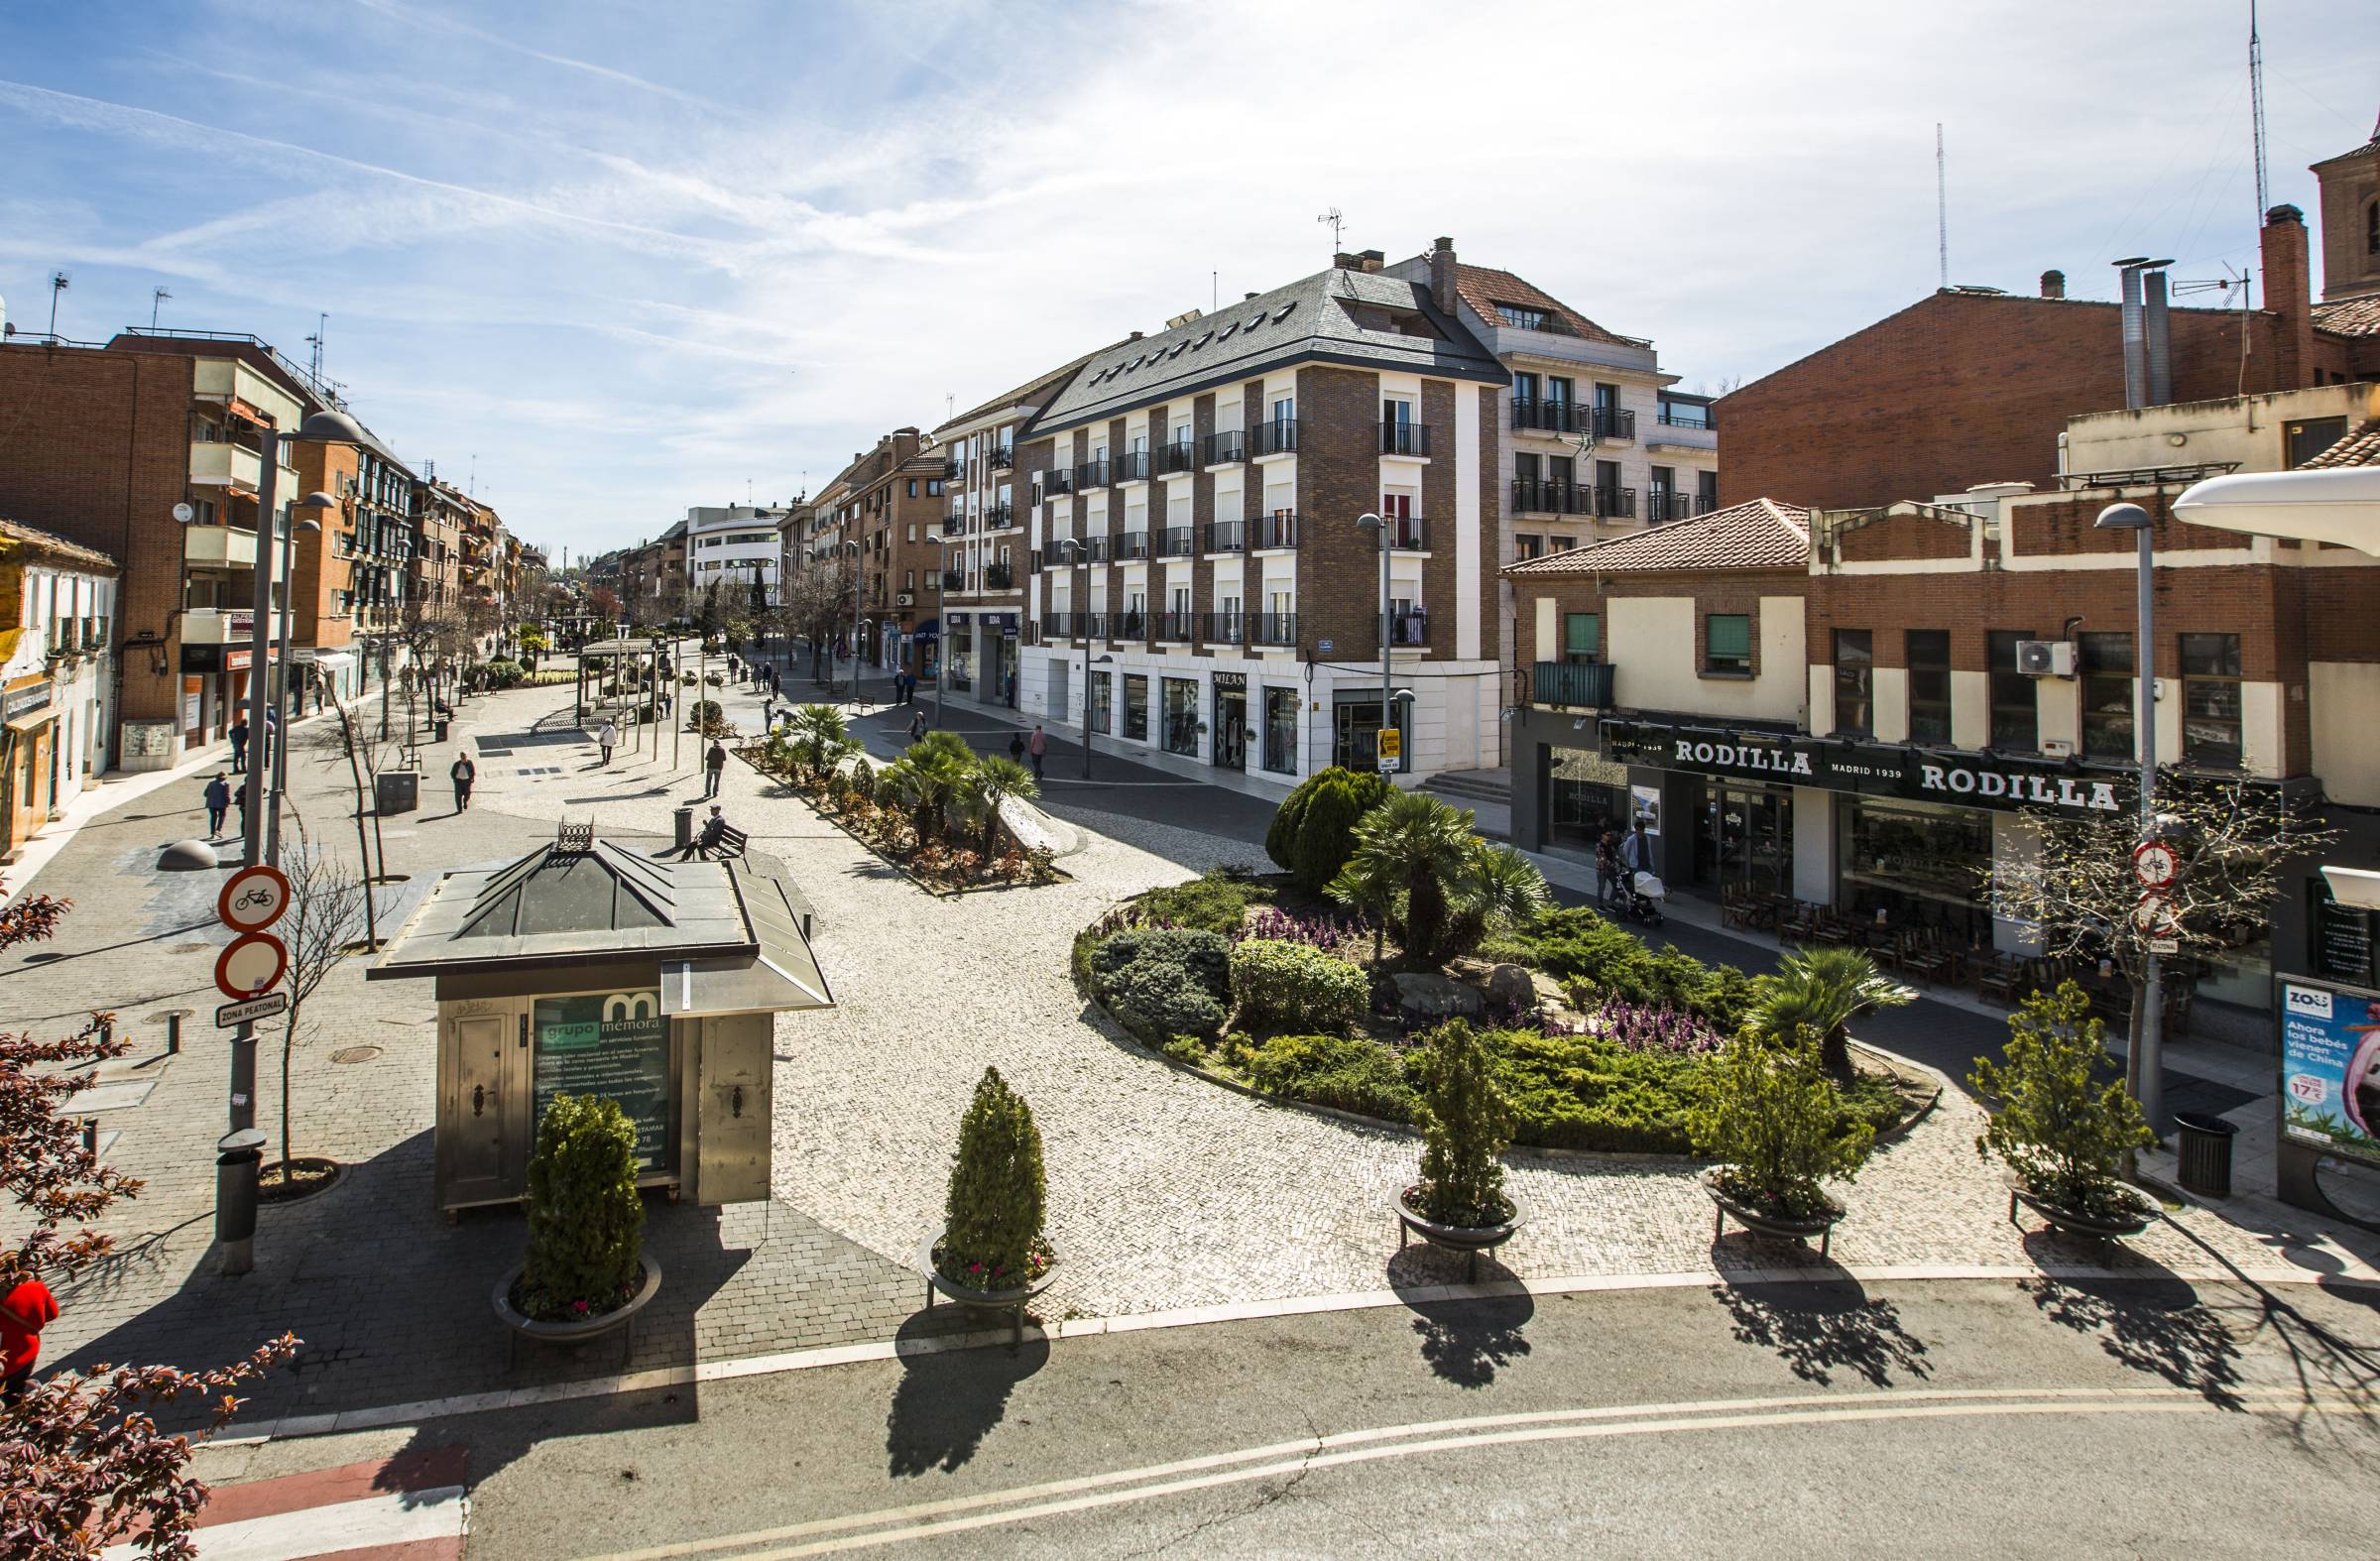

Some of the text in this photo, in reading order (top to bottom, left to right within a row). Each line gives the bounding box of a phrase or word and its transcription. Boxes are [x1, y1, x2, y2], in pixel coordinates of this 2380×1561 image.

[1213, 674, 1246, 685] MILAN
[1675, 741, 1812, 776] RODILLA
[1832, 763, 1902, 779] MADRID 1939
[1921, 765, 2119, 811] RODILLA
[1569, 792, 1607, 805] RODILLA
[222, 1000, 282, 1021] ZONA PEATONAL
[547, 1024, 594, 1039] grupo
[601, 1020, 659, 1032] mémora
[2288, 1021, 2325, 1035] Ahora
[2288, 1029, 2348, 1050] los bebés
[2288, 1039, 2330, 1055] vienen
[2289, 1049, 2344, 1068] de China
